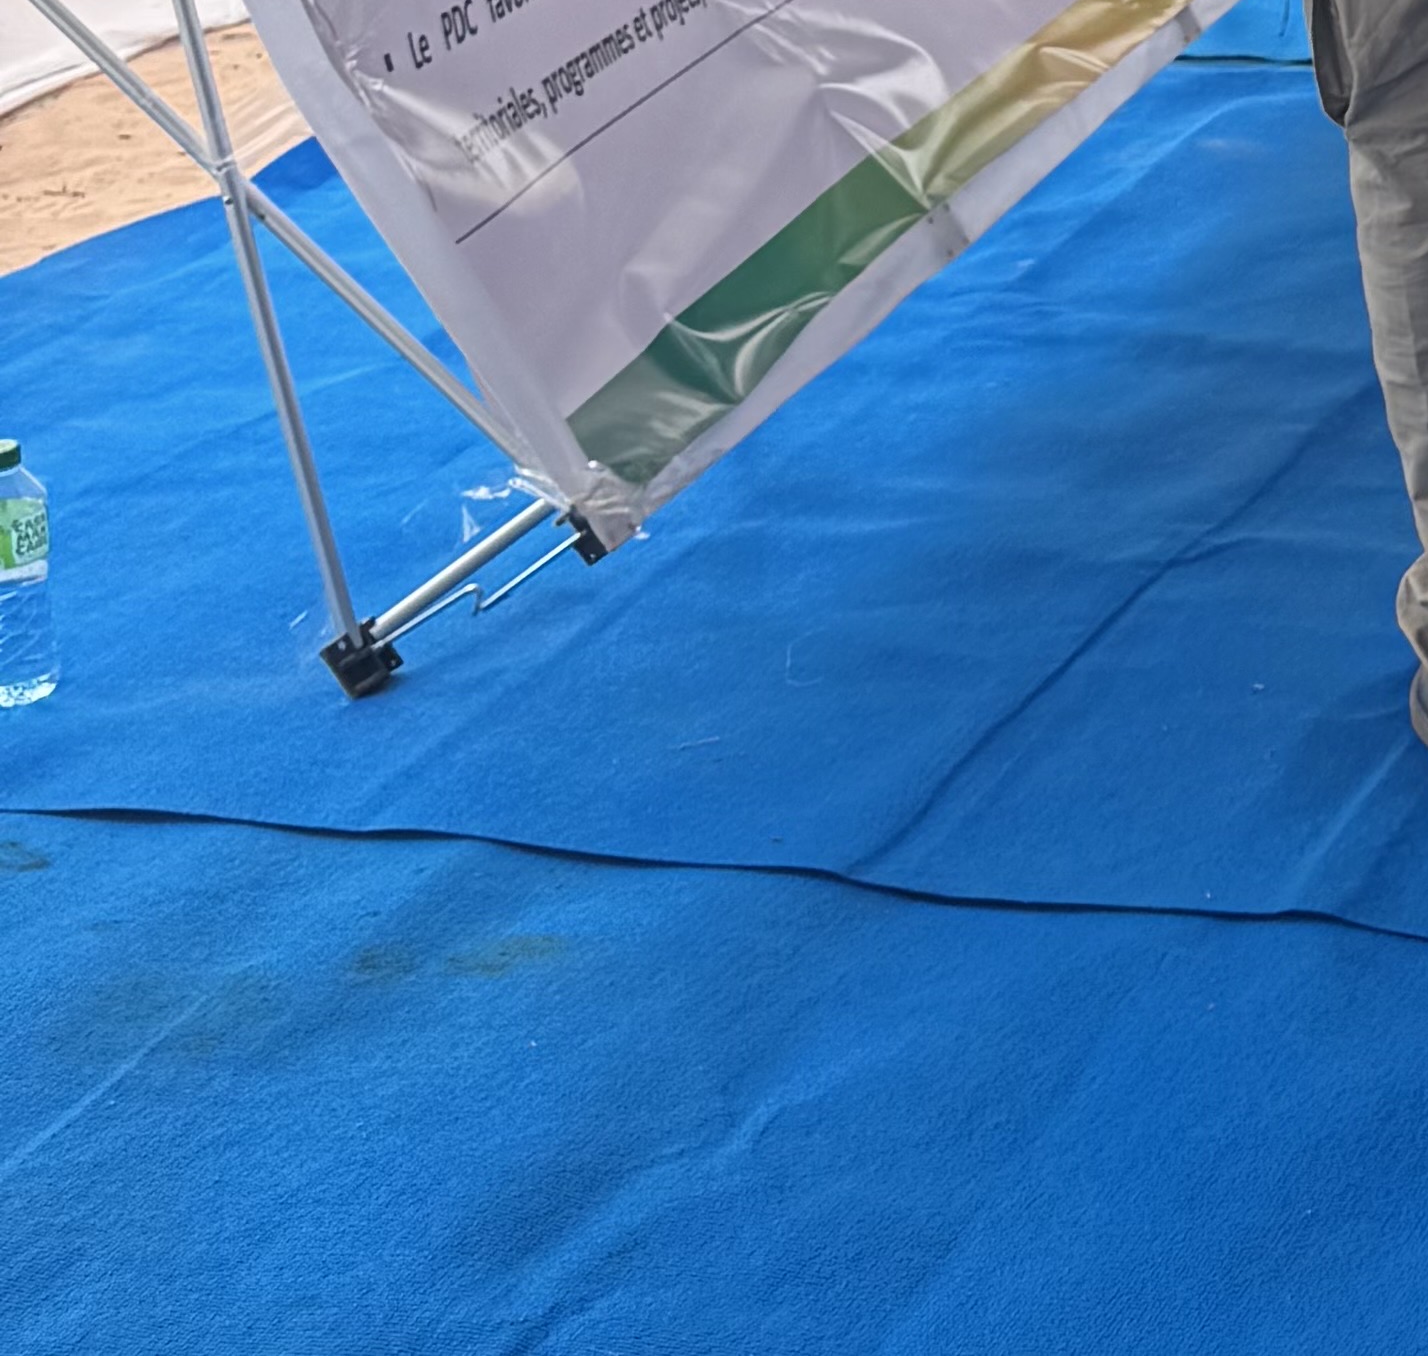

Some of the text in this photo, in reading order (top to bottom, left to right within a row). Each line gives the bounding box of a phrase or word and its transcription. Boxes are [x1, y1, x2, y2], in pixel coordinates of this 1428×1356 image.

[407, 31, 433, 71] Le
[540, 24, 636, 115] programmes
[630, 3, 652, 44] et
